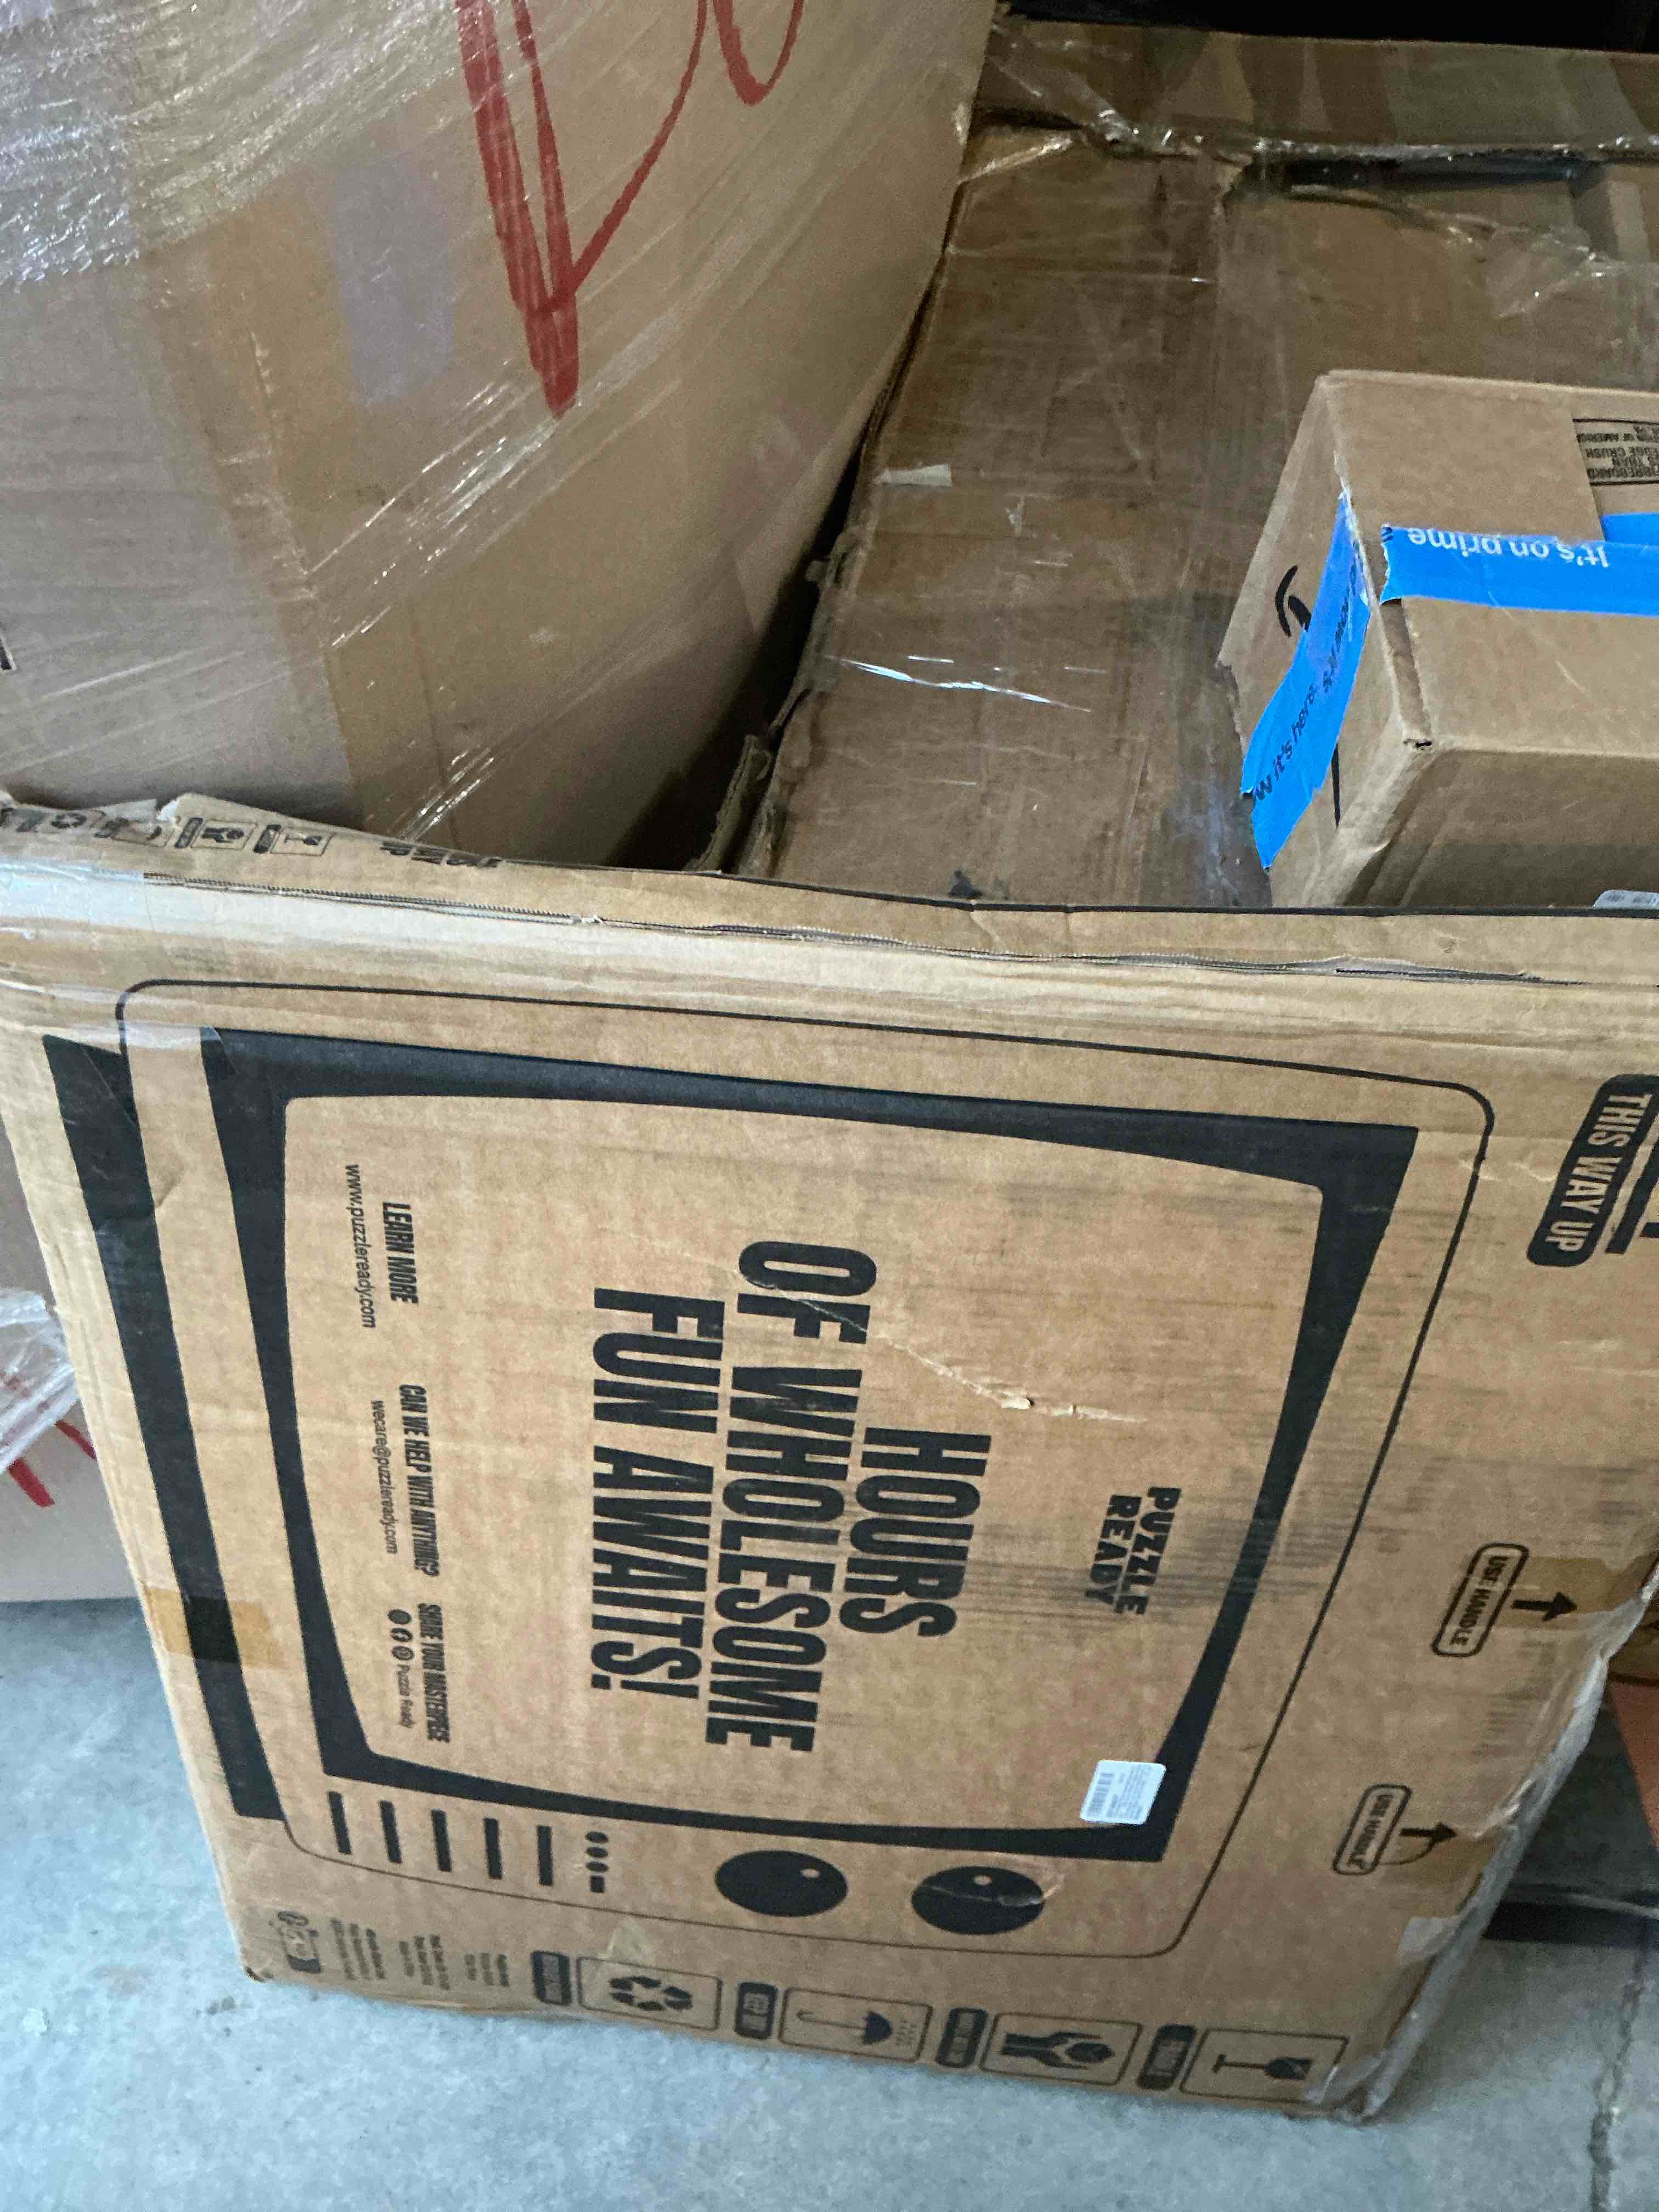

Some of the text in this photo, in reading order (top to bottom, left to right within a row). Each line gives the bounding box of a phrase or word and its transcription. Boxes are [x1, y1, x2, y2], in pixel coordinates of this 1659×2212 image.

[1408, 528, 1610, 567] It's on prime
[345, 1164, 377, 1328] www.puzzleready.com
[1545, 1093, 1651, 1251] THIS WAY UP
[382, 1203, 418, 1303] LEARN MORE
[371, 1400, 398, 1554] wecare@puzzleready.com
[399, 1385, 439, 1576] CAN WE HELP WITH ANYTHING?
[591, 1288, 726, 1699] FUN AWAITS!
[706, 1242, 877, 1752] OF WHOLESOME
[838, 1427, 991, 1637] HOURS
[1085, 1495, 1142, 1605] READY
[1114, 1487, 1181, 1615] PUZZLE
